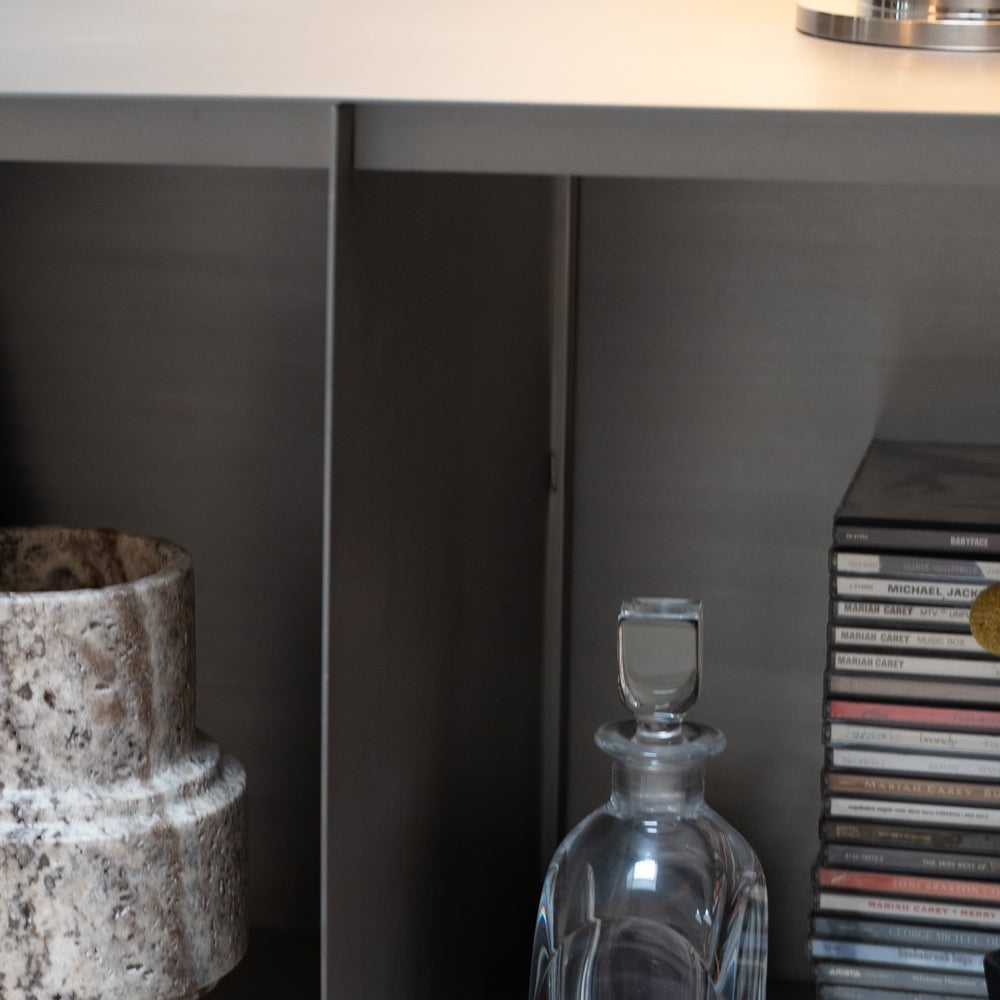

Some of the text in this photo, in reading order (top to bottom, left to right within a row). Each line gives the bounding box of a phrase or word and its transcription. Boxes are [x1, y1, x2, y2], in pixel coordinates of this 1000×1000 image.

[950, 535, 989, 548] BABYFACE
[887, 583, 943, 597] MICHAEL
[947, 585, 979, 598] JACK
[843, 603, 880, 614] MARIAH
[884, 605, 913, 616] CAREY
[840, 630, 878, 642] MARIAH
[880, 632, 910, 644] CAREY
[947, 636, 966, 646] BOX
[837, 654, 905, 669] MARIAH CAREY
[864, 780, 922, 793] MARIAH
[927, 783, 974, 797] CAREY
[868, 900, 997, 919] MARIAH CAREY MERRY
